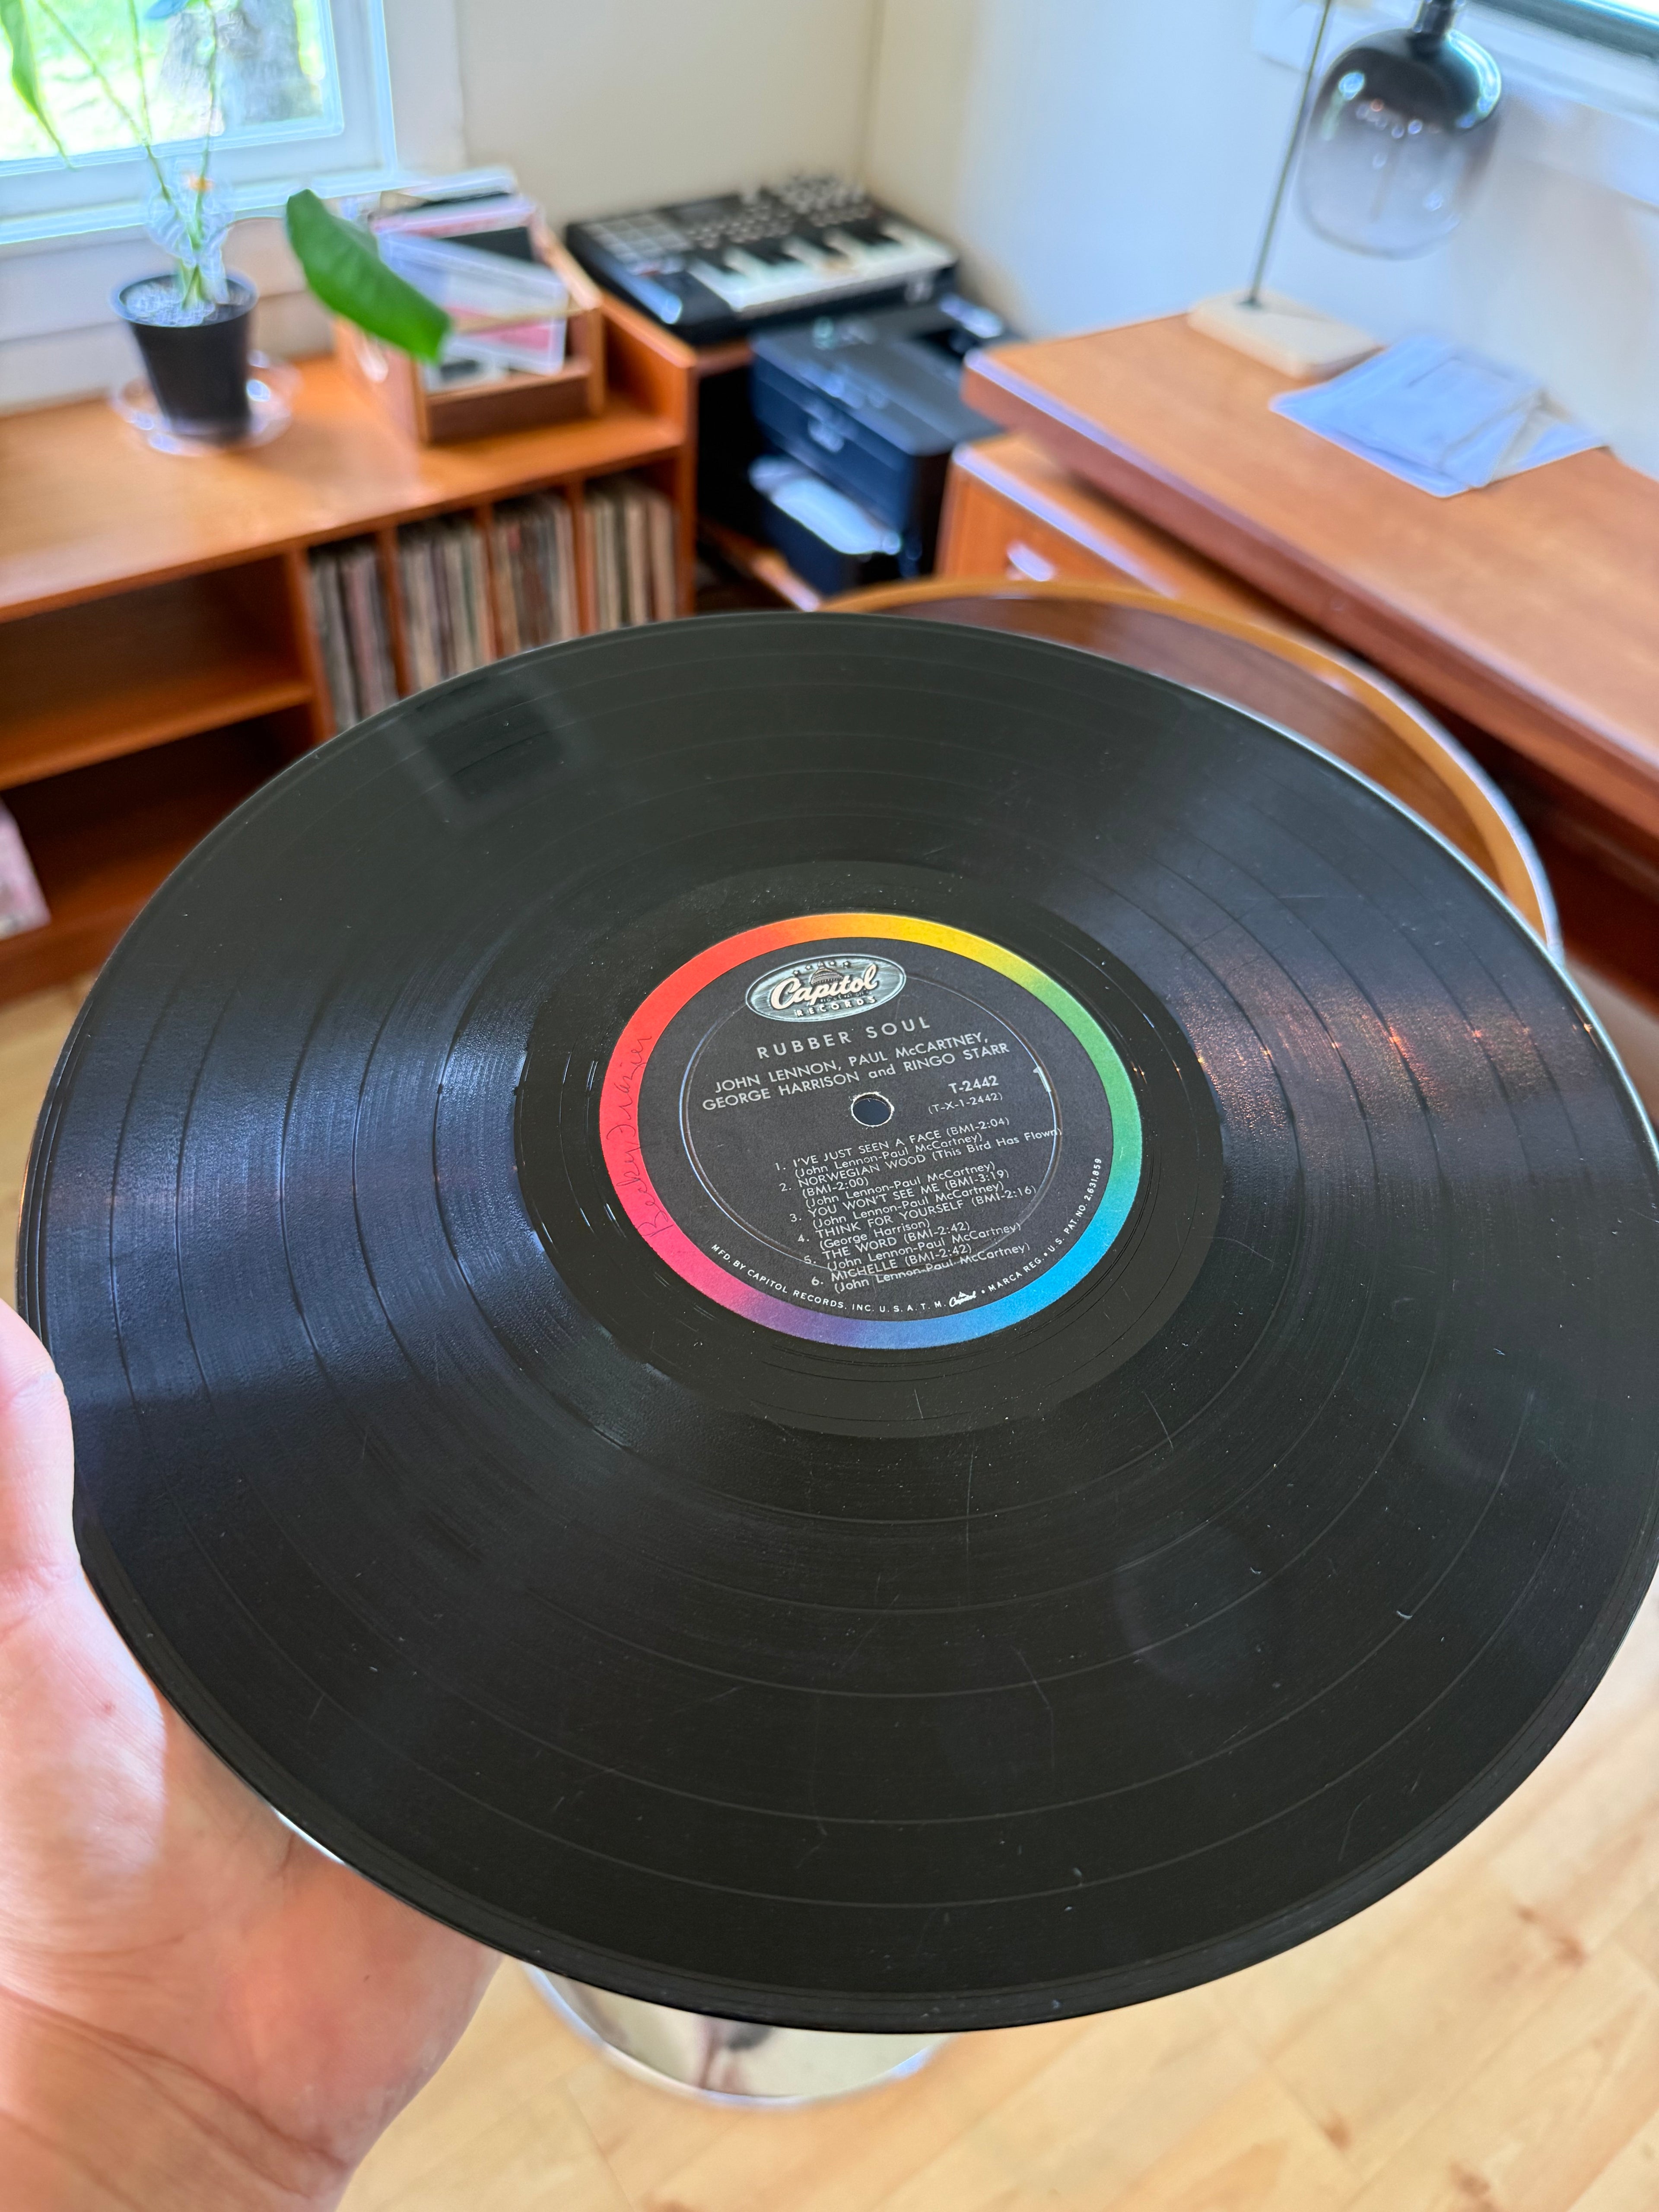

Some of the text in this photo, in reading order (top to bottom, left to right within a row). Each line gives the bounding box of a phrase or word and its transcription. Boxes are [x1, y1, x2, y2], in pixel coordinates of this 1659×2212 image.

[770, 963, 878, 1010] Capitol
[796, 997, 876, 1017] RECORDS
[757, 1017, 930, 1059] RUBBER SOUL
[702, 1043, 1010, 1110] GEORGE HARRISON and RINGO STARR
[715, 1032, 988, 1093] JOHN LENNON, PAUL McCARTNEY,
[948, 1075, 999, 1093] T-2442
[928, 1092, 1002, 1114] (T-X-1-2442)
[779, 1128, 1062, 1192] 2. NORWEGIAN WOOD (This Bird Has Flown)
[793, 1155, 818, 1167] I'VE
[823, 1148, 852, 1161] JUST
[858, 1141, 889, 1154] SEEN
[896, 1138, 905, 1147] A
[909, 1130, 941, 1144] FACE
[946, 1117, 1009, 1137] (BMI-2:04)
[795, 1132, 982, 1179] (John Lennon-Paul McCartney)
[789, 1169, 1009, 1222] 3. YOU WON'T SEE ME (BMI-3:19)
[802, 1176, 869, 1198] (BMI-2:00)
[806, 1161, 995, 1209] (John Lennon-Paul McCartney)
[813, 1181, 1004, 1230] (John Lennon-Paul McCartney)
[798, 1185, 1036, 1243] 4. THINK FOR YOURSELF (BMI-2:16)
[820, 1218, 930, 1251] (George Harrison)
[804, 1221, 970, 1265] 5. THE WORD (BMI-2:42)
[811, 1243, 972, 1286] 6. MICHELLE (BMI-2:42)
[827, 1222, 1021, 1271] (John Lennon-Paul McCartney)
[711, 1244, 731, 1263] MFD.
[733, 1260, 746, 1271] BY
[747, 1269, 788, 1294] CAPITOL
[852, 1303, 874, 1312] INC.
[988, 1271, 1022, 1292] MARCA
[1023, 1257, 1044, 1272] REG.
[834, 1243, 1030, 1294] (John Lennon-Paul McCartney)
